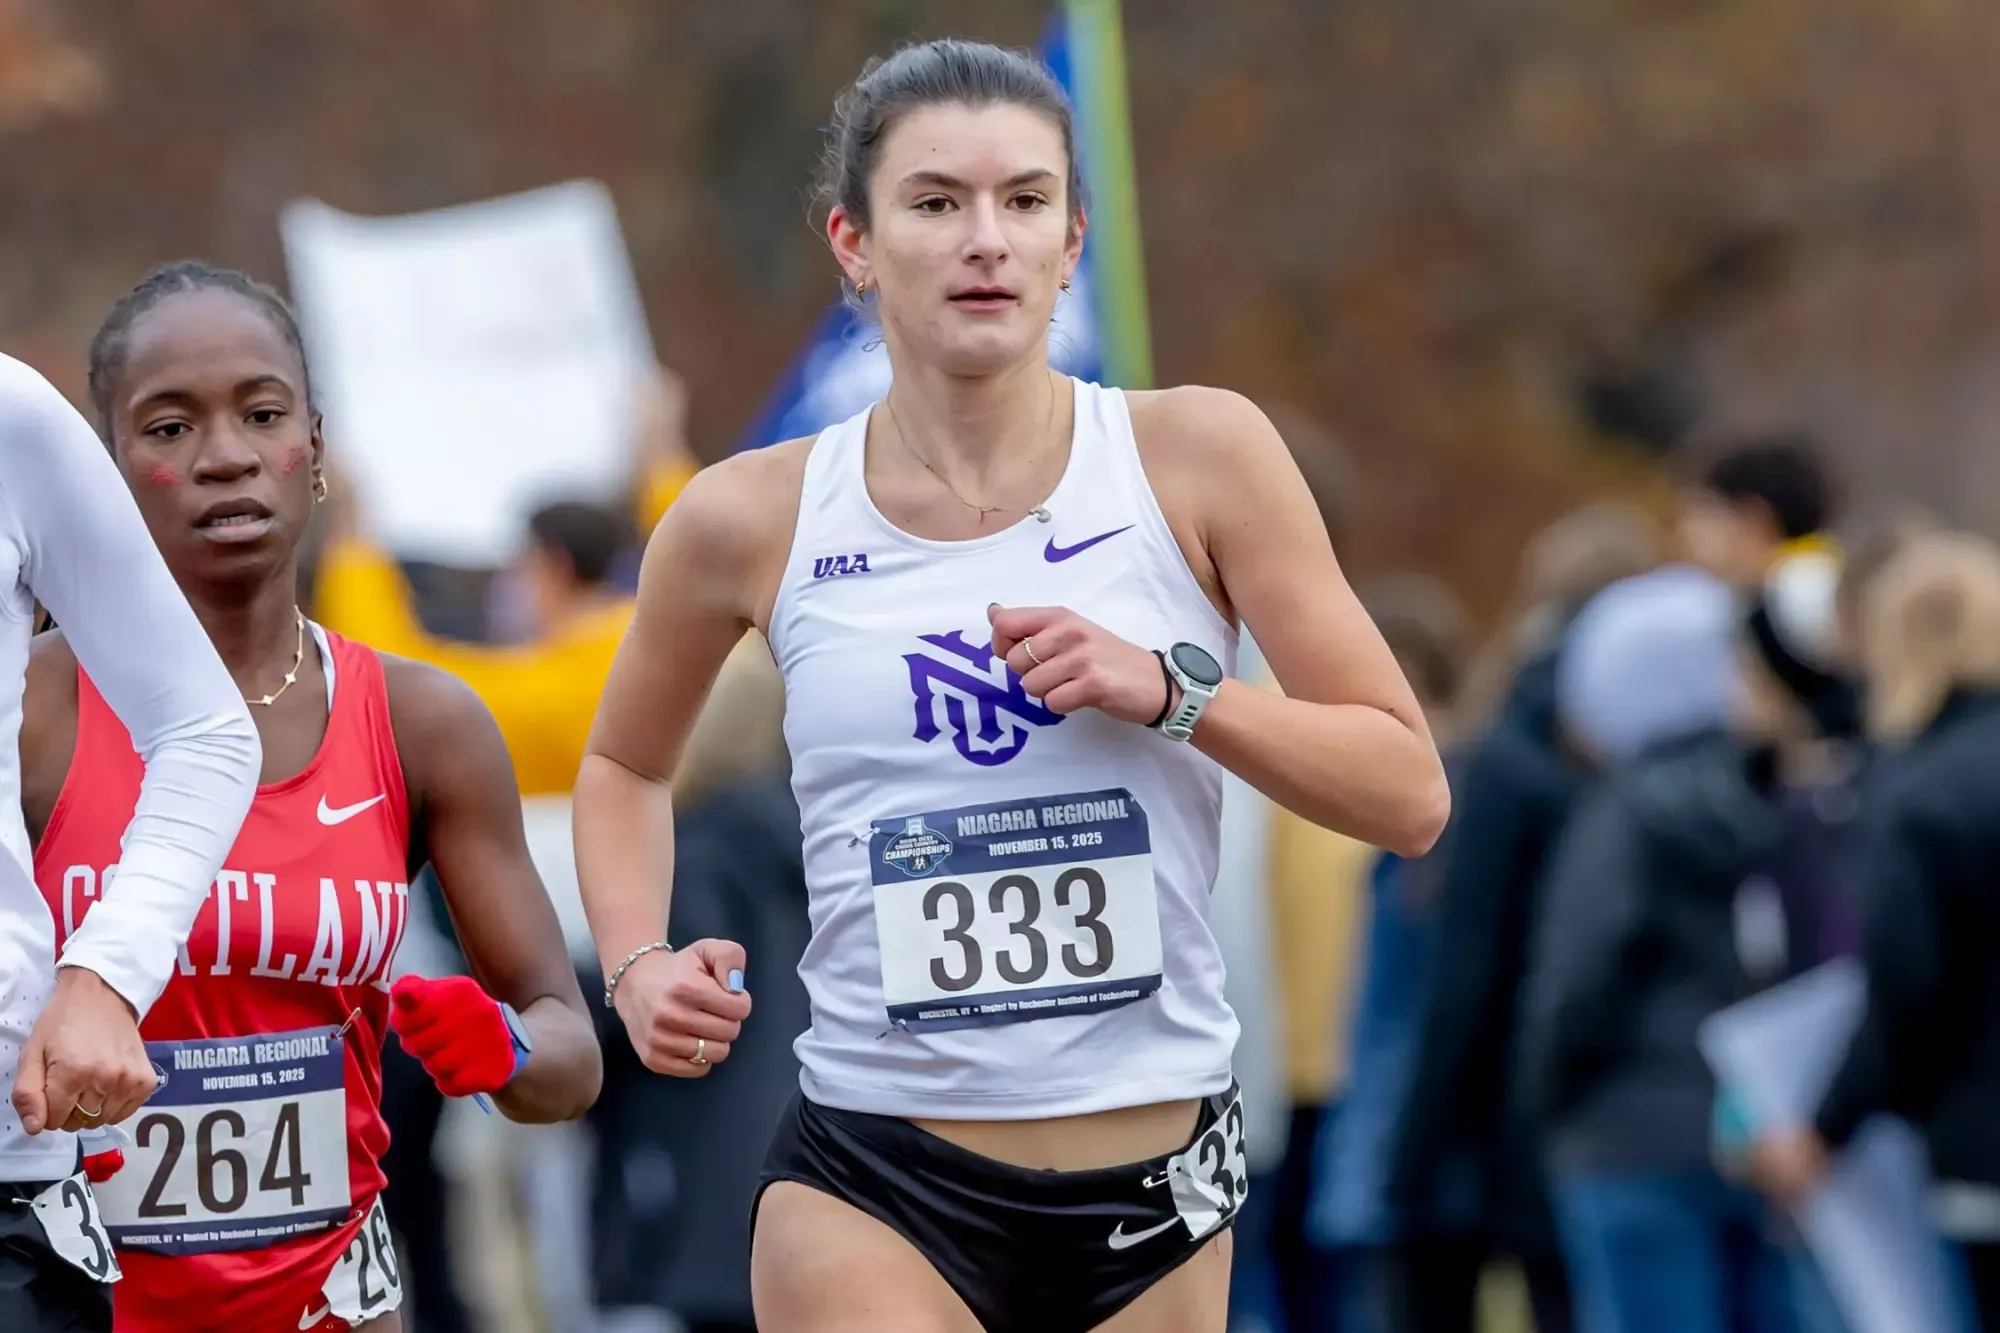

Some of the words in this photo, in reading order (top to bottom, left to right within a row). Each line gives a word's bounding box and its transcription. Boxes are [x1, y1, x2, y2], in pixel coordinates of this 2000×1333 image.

[813, 553, 872, 579] UAA
[957, 808, 1038, 836] NIAGARA
[1043, 799, 1129, 828] REGIONAL
[885, 843, 951, 861] CHAMPIONSHIPS
[989, 838, 1048, 856] NOVEMBER
[1052, 836, 1069, 851] 15,
[1072, 832, 1103, 848] 2025
[922, 867, 1114, 992] 333
[980, 1002, 1007, 1014] Hosted
[1008, 1002, 1018, 1011] by
[1019, 998, 1056, 1010] Rochester
[1089, 993, 1097, 1003] of
[1098, 989, 1140, 1002] Technology
[174, 1045, 250, 1070] NIAGARA
[255, 1036, 330, 1064] REGIONAL
[203, 1073, 258, 1091] NOVEMBER
[260, 1072, 277, 1086] 15,
[279, 1068, 305, 1083] 2025
[136, 1102, 311, 1218] 264
[343, 1205, 398, 1310] 26
